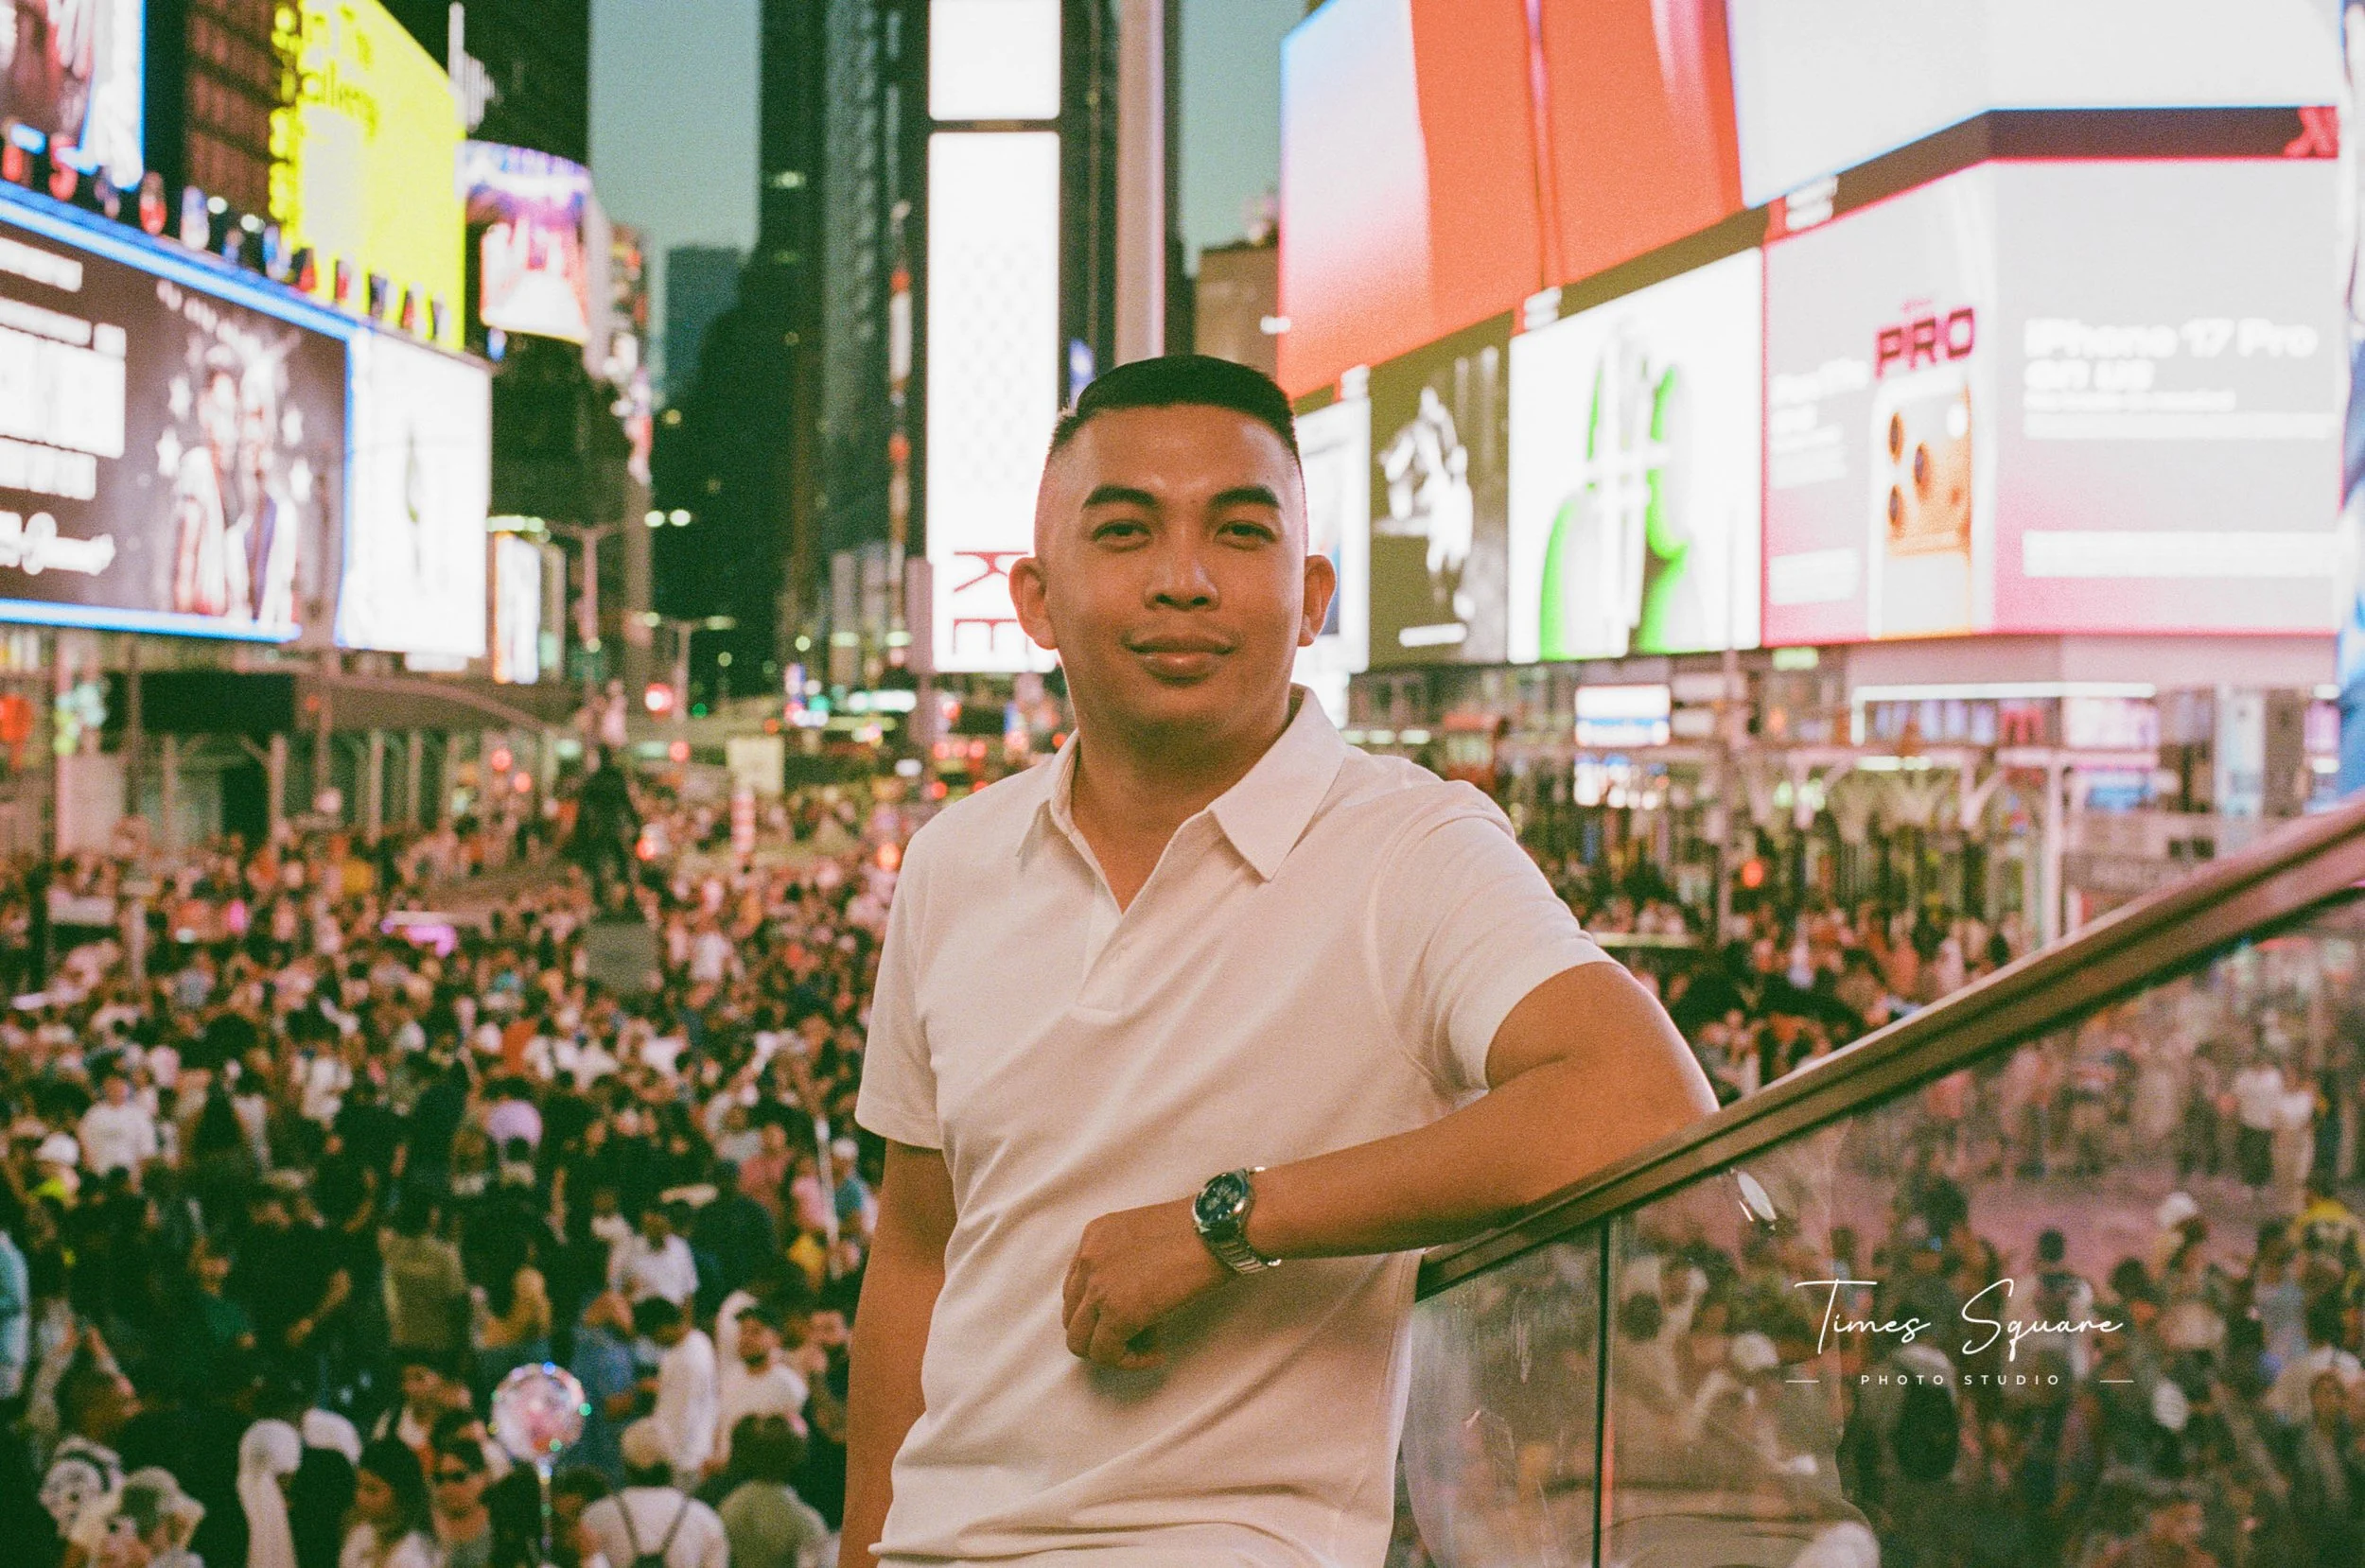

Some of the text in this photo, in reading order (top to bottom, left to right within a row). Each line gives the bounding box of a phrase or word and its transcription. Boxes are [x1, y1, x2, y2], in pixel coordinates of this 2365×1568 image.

[1876, 306, 1974, 379] PRO
[2180, 319, 2234, 357] 17
[2238, 319, 2318, 357] Pro
